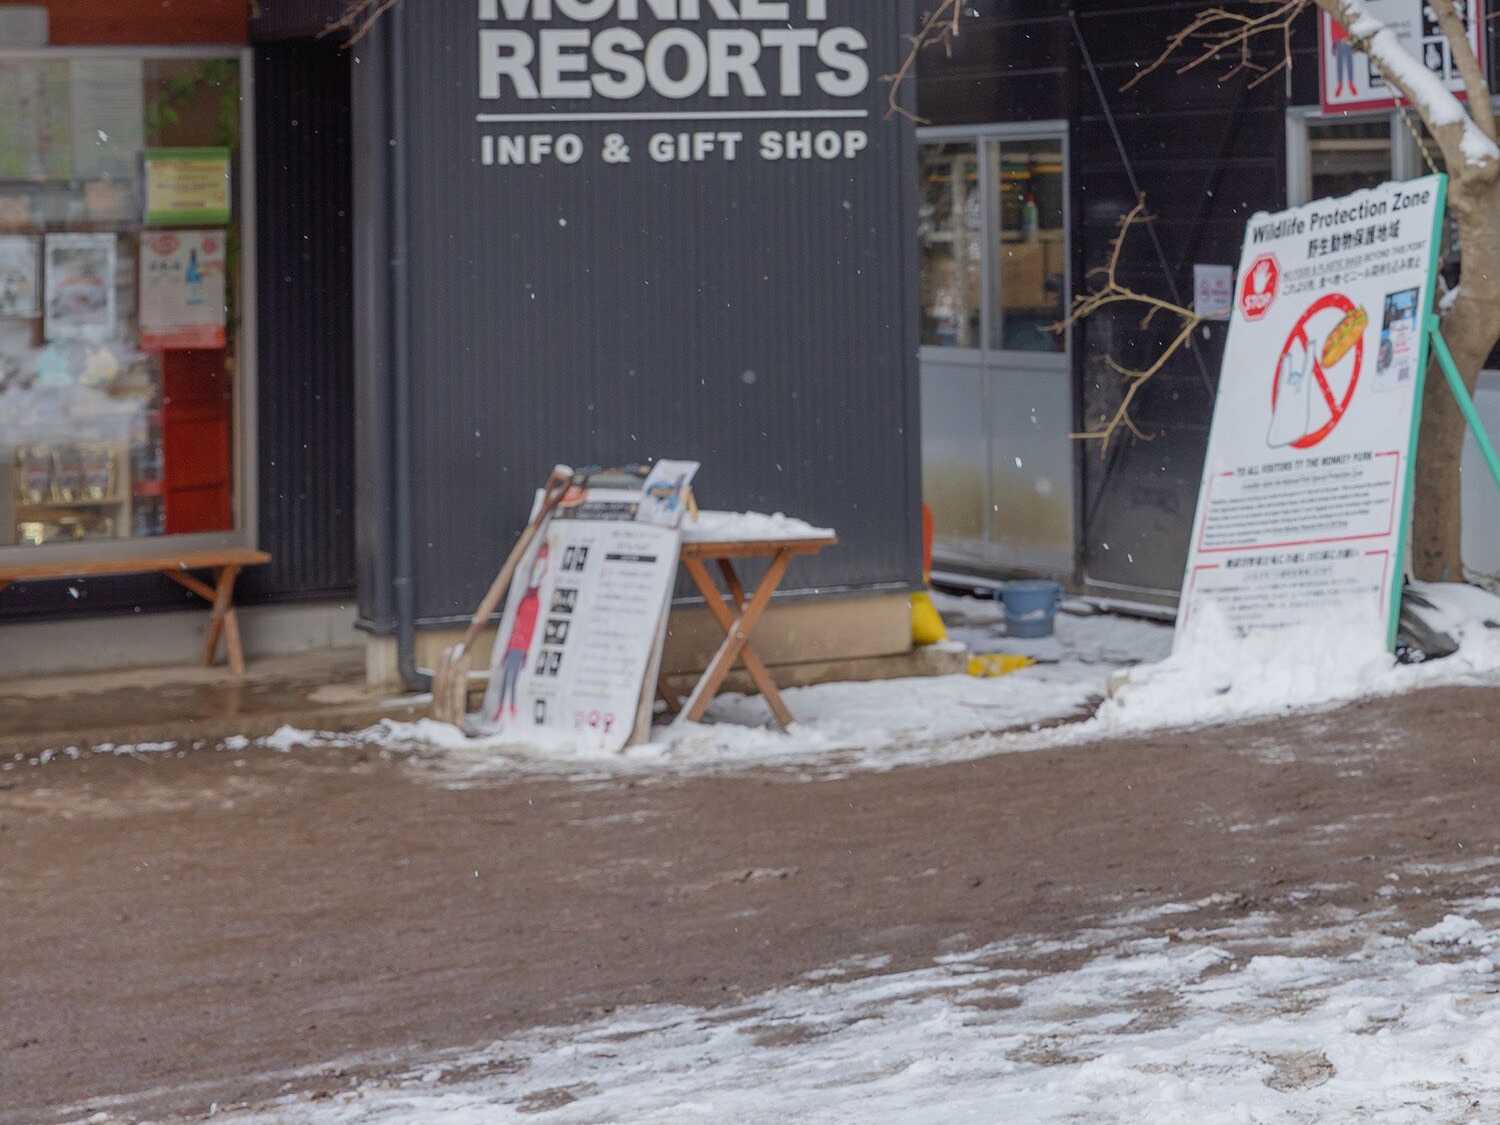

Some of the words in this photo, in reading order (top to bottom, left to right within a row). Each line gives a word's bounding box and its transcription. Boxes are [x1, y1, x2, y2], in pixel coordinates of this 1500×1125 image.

[478, 26, 869, 100] RESORTS
[481, 133, 584, 165] INFO
[601, 133, 631, 163] &
[648, 132, 742, 162] GIFT
[759, 130, 868, 161] SHOP
[1252, 217, 1305, 244] Wildlife
[1310, 200, 1387, 232] Protection
[1392, 189, 1430, 212] Zone
[1307, 220, 1400, 259] 野生動物保護地域
